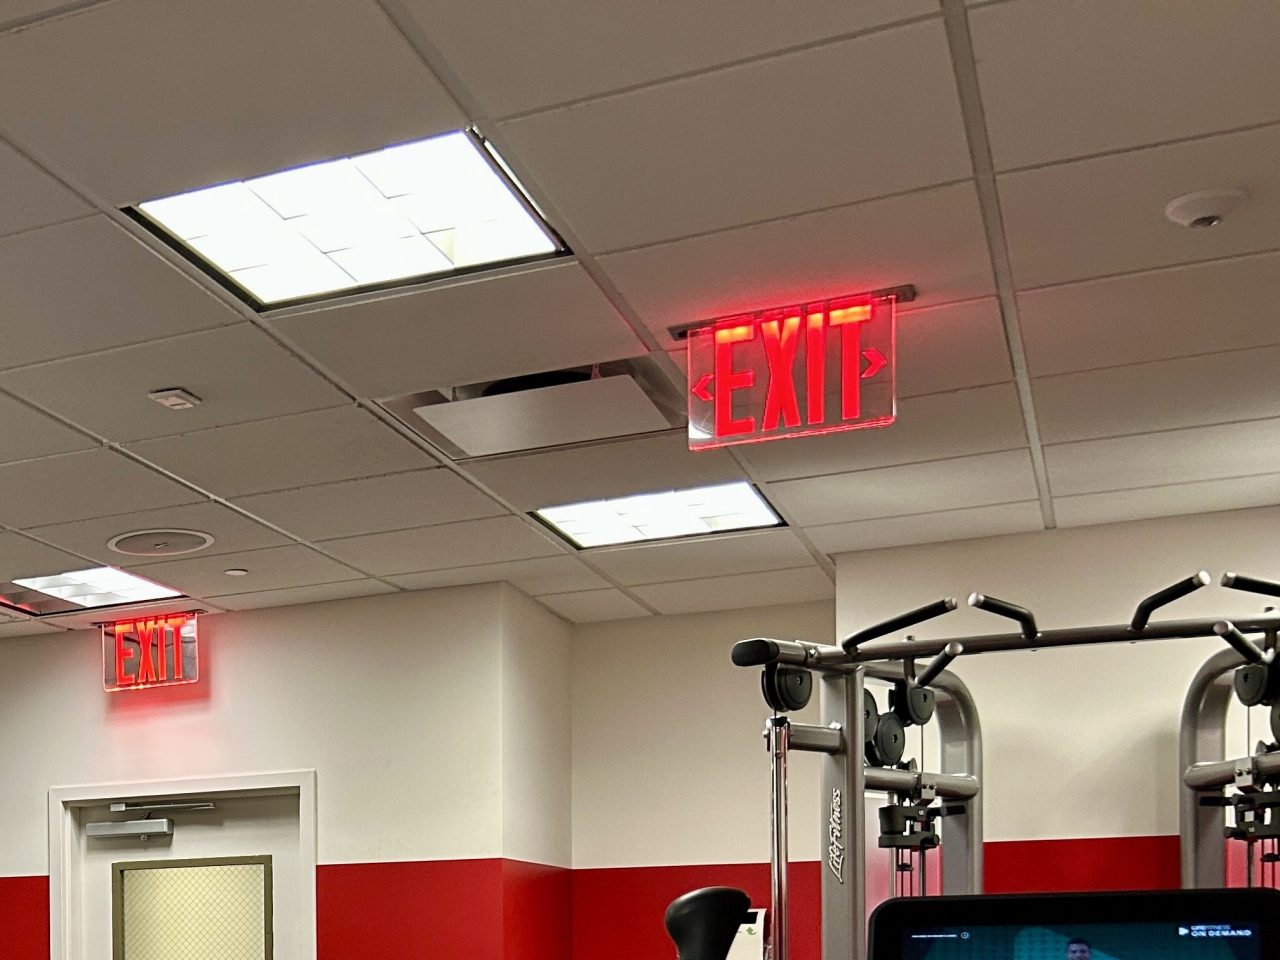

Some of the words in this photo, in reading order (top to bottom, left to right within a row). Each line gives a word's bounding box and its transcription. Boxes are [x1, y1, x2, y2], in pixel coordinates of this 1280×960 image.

[715, 303, 872, 438] EXIT
[115, 617, 186, 686] EXIT
[1191, 930, 1207, 938] ON
[1208, 929, 1252, 937] DEMAND
